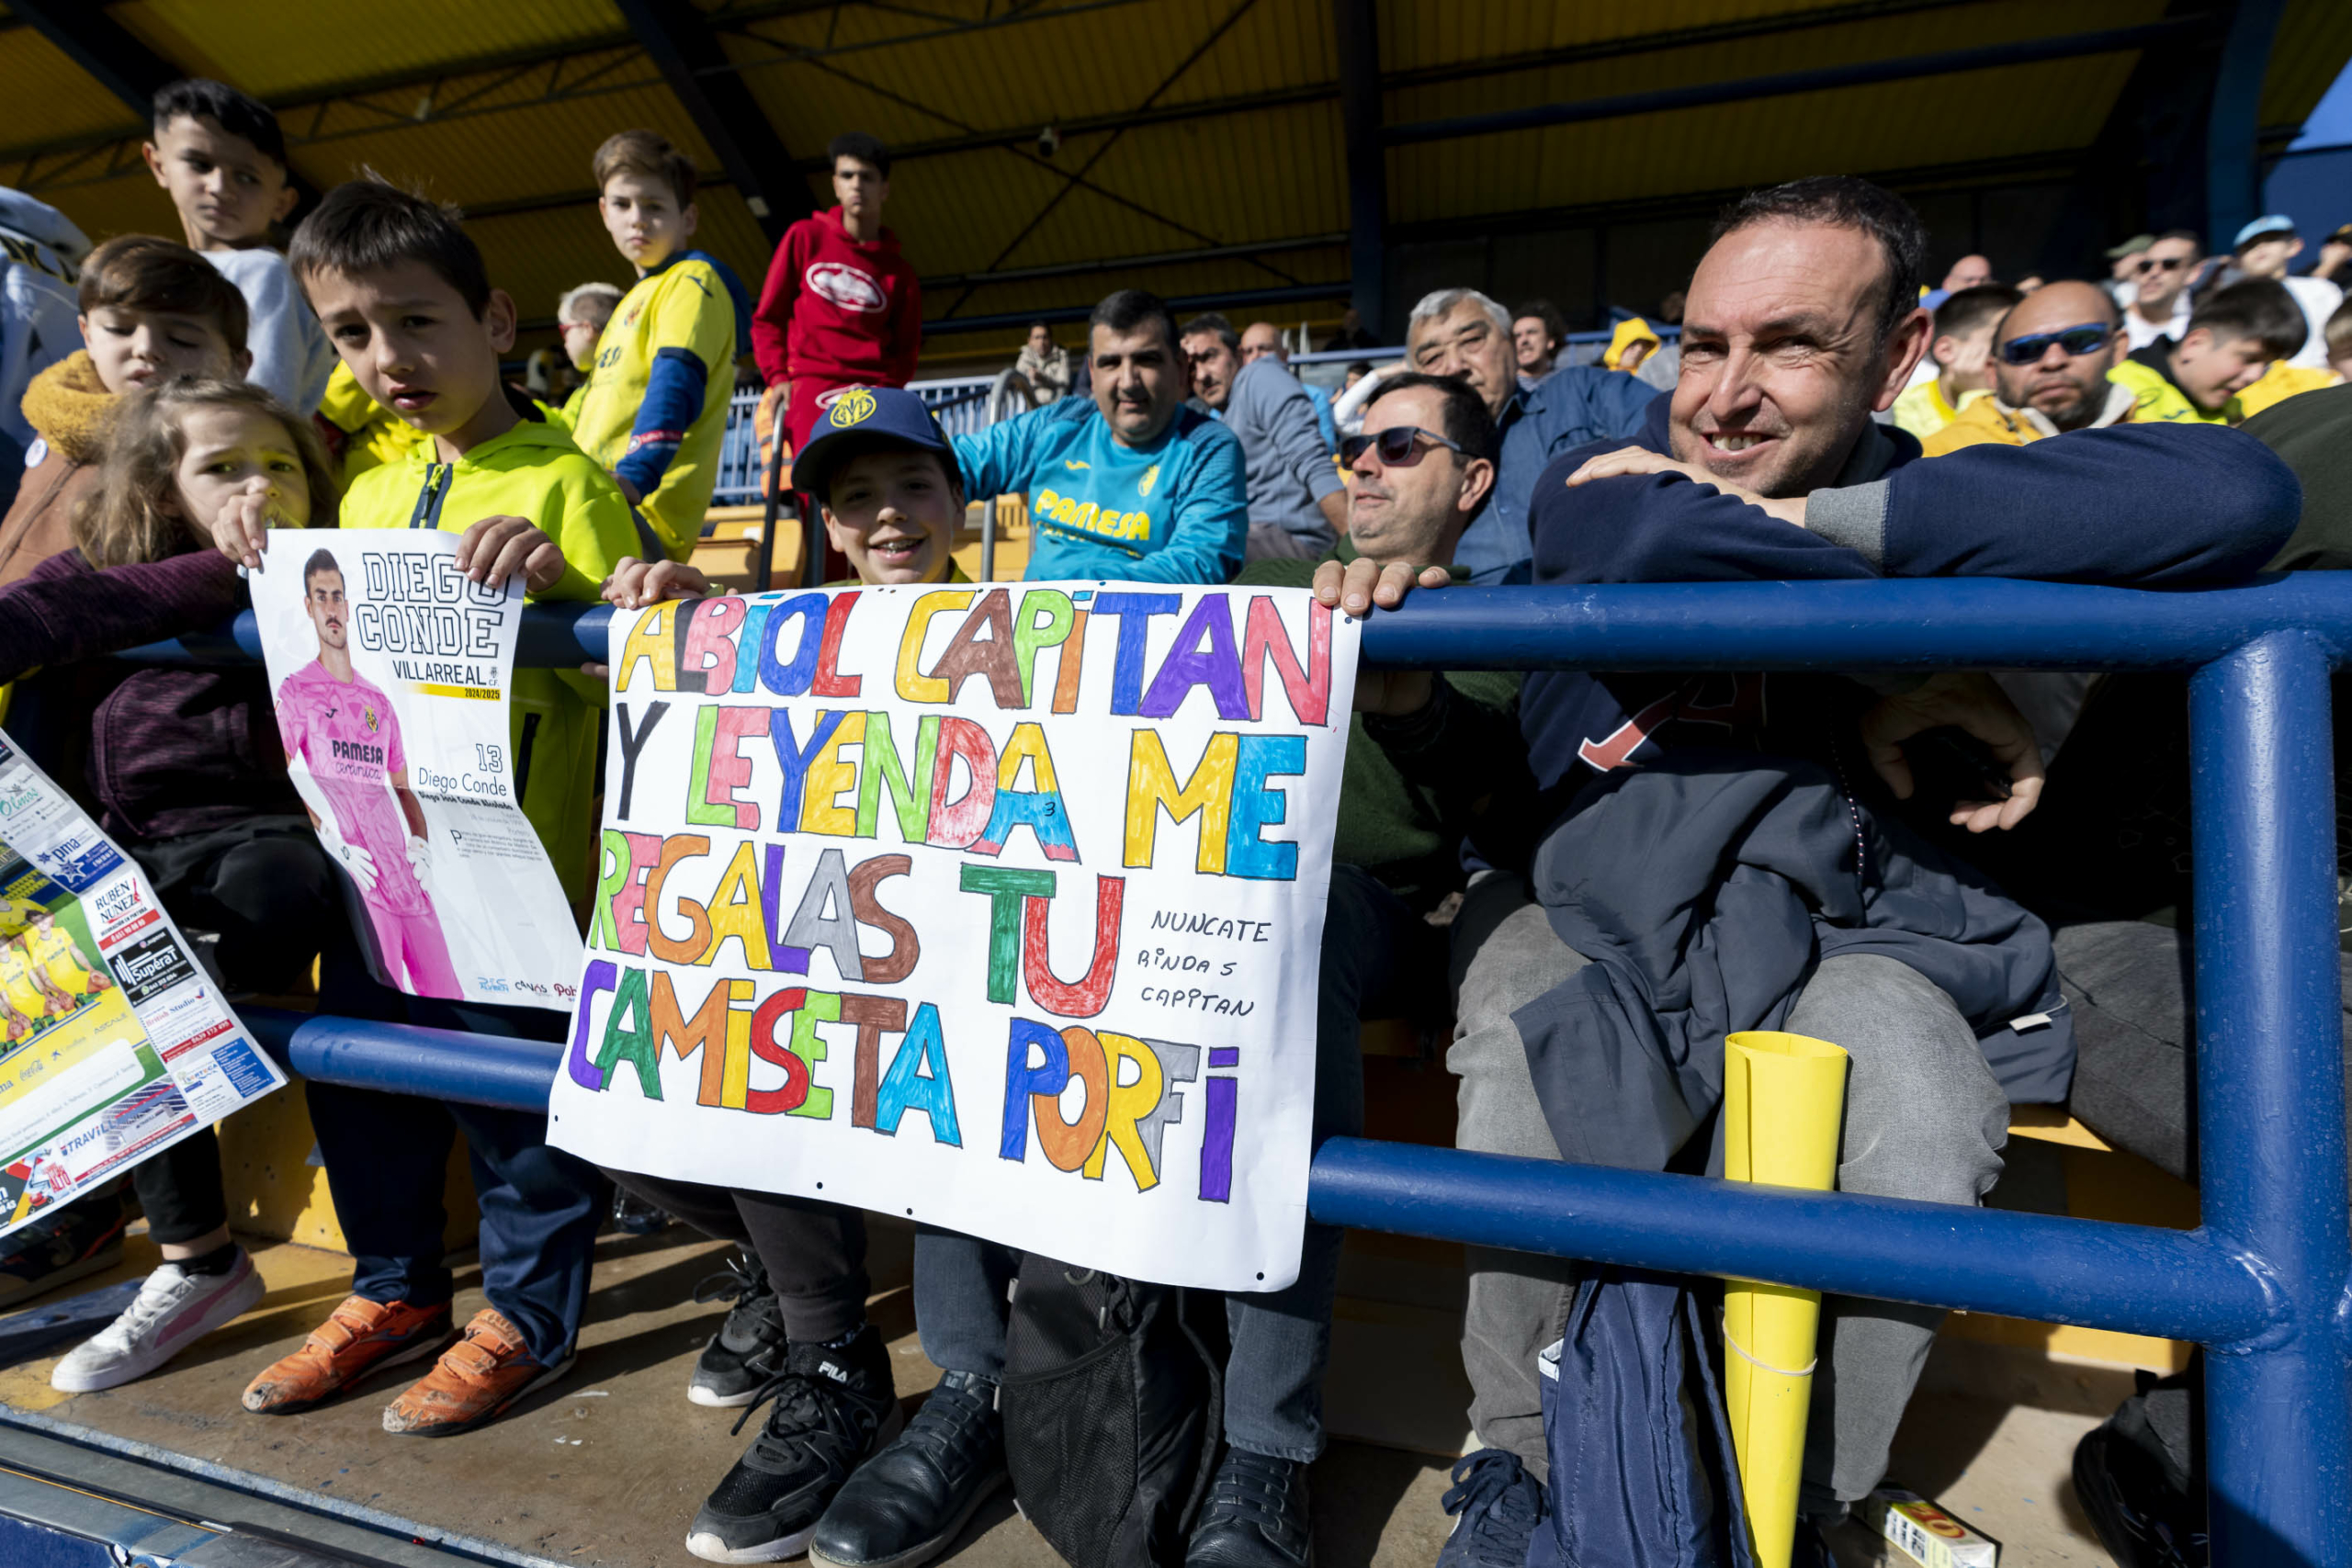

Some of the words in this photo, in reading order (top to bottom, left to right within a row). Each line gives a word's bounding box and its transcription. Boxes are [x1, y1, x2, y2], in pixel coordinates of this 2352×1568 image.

[1035, 488, 1150, 541] PAMESA
[356, 604, 504, 659] CONDE
[392, 660, 487, 686] VILLARREAL
[465, 688, 501, 700] 2024/2025
[332, 739, 384, 765] PAMESA
[476, 743, 503, 773] 13
[418, 767, 458, 794] Diego
[461, 772, 507, 796] Conde
[616, 700, 672, 820] Y
[685, 704, 1081, 865] LEYENDA
[1123, 728, 1309, 880] ME
[51, 837, 81, 863] pma
[589, 828, 921, 984] REGALAS
[959, 862, 1125, 1020] TU
[169, 998, 196, 1013] Studio
[818, 1360, 848, 1384] FILA
